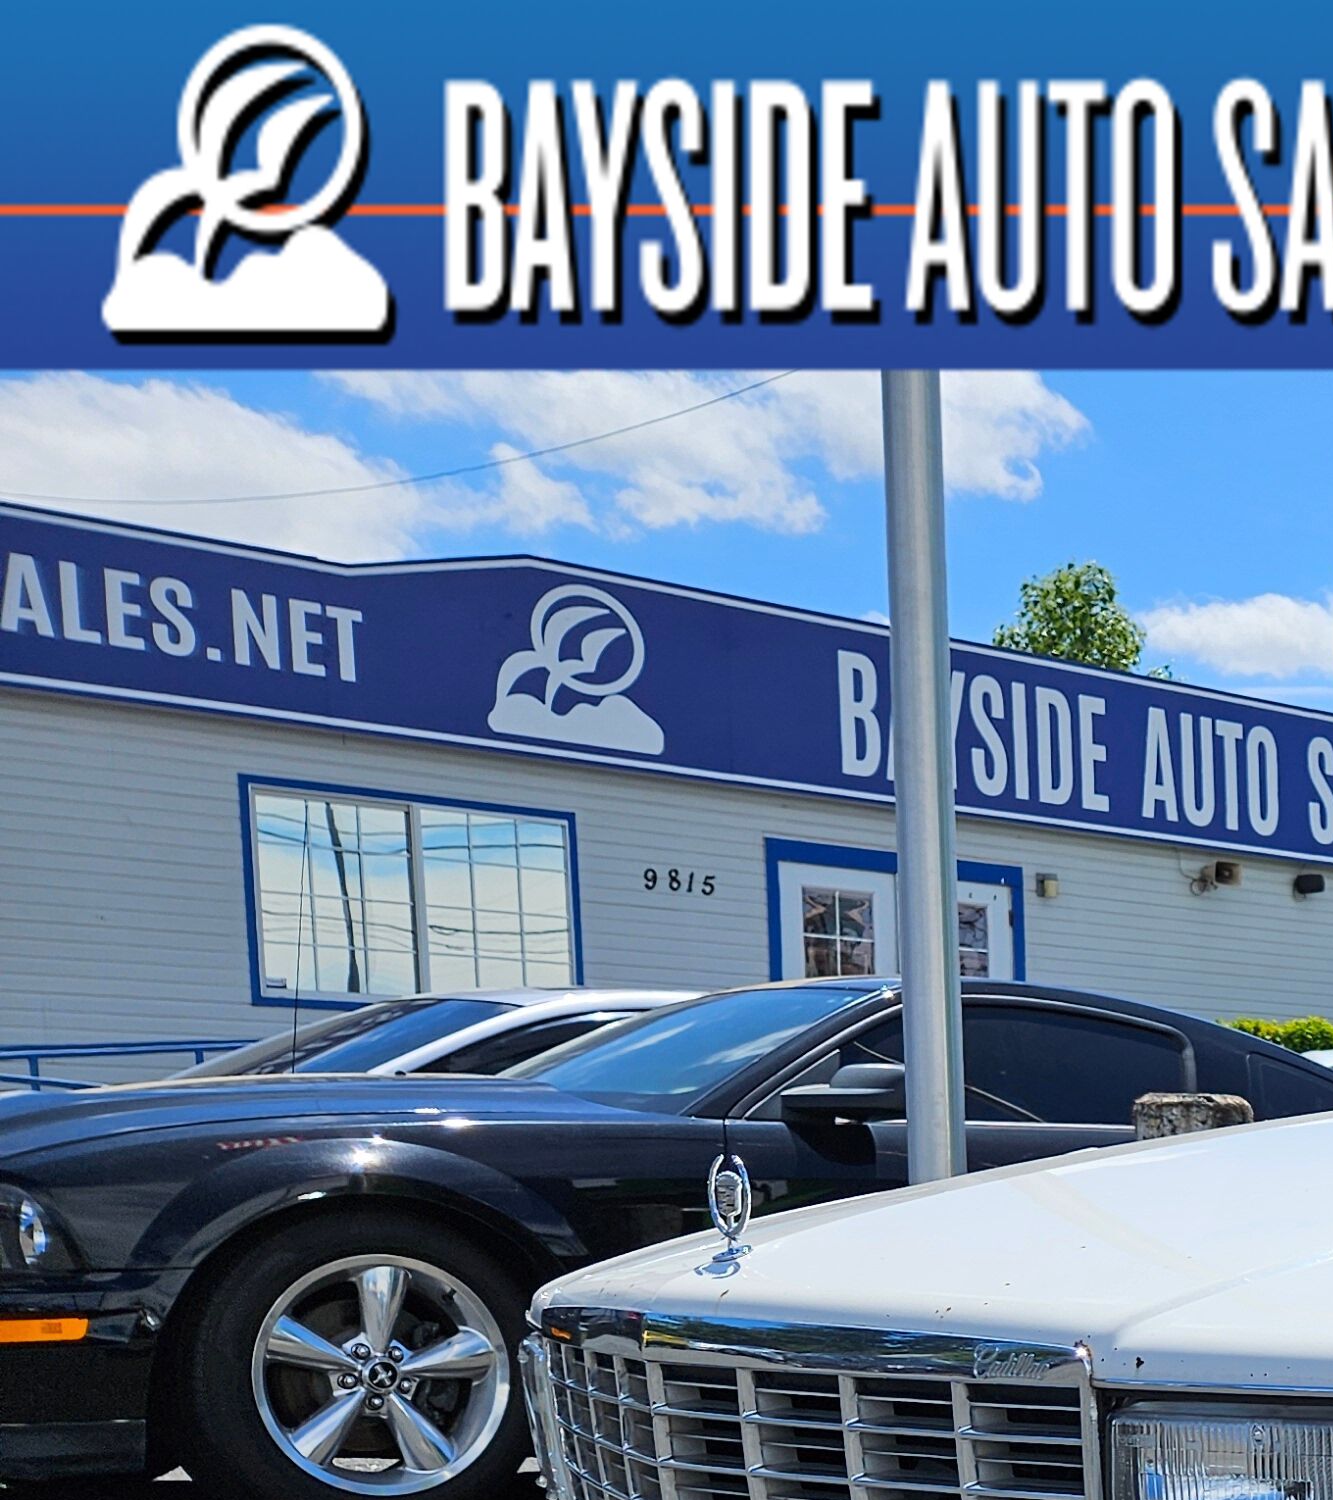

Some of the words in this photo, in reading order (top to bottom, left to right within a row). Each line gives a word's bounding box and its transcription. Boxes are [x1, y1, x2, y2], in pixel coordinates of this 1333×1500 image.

[837, 649, 1110, 813] BSIDE
[1141, 706, 1279, 837] AUTO
[643, 868, 716, 896] 9815
